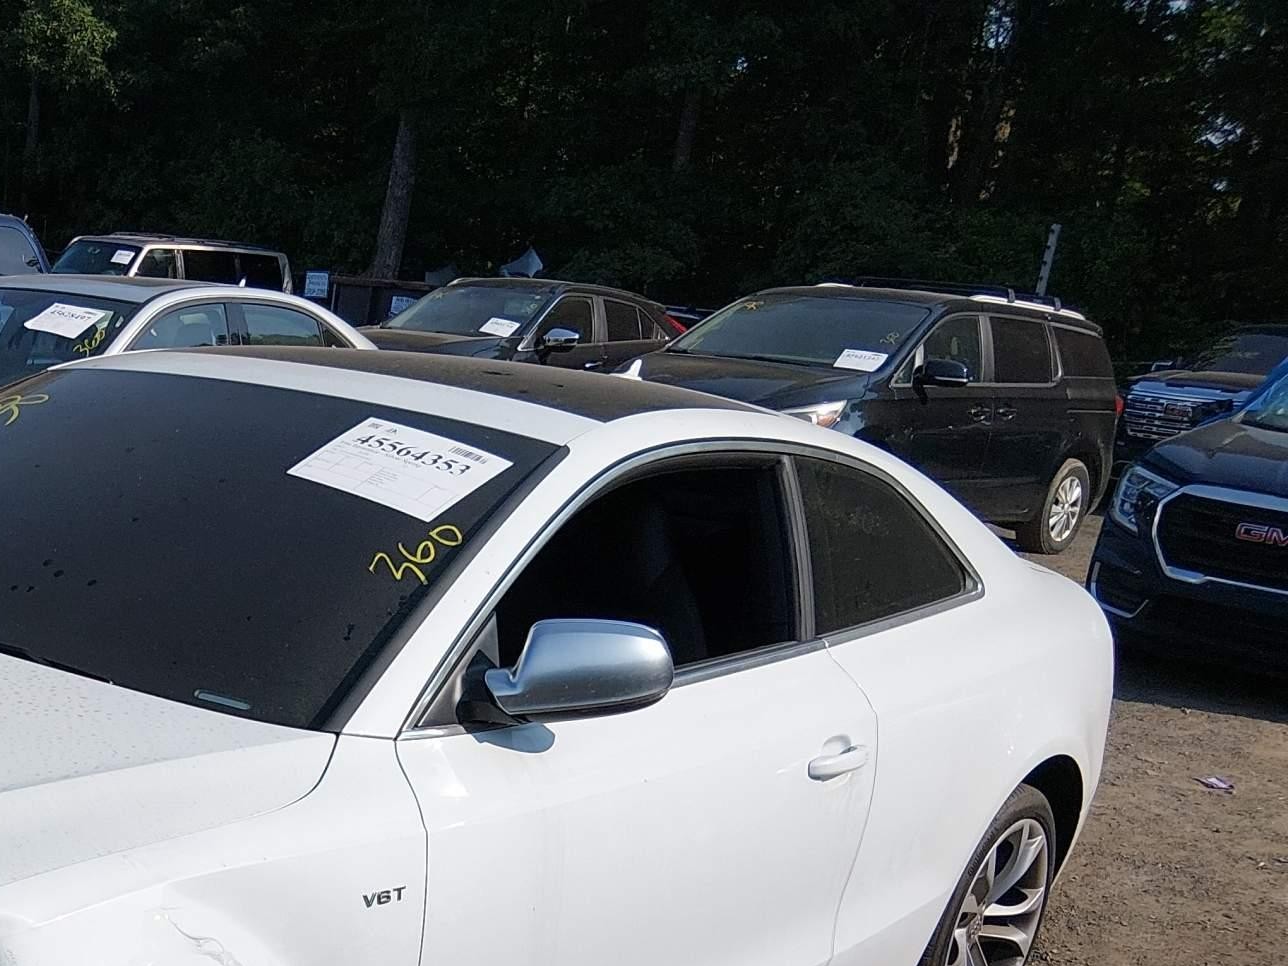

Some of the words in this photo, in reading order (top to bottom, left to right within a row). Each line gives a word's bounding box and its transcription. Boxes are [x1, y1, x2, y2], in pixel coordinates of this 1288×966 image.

[355, 434, 472, 476] 45564353
[368, 524, 463, 586] 360
[362, 885, 407, 909] V6T
